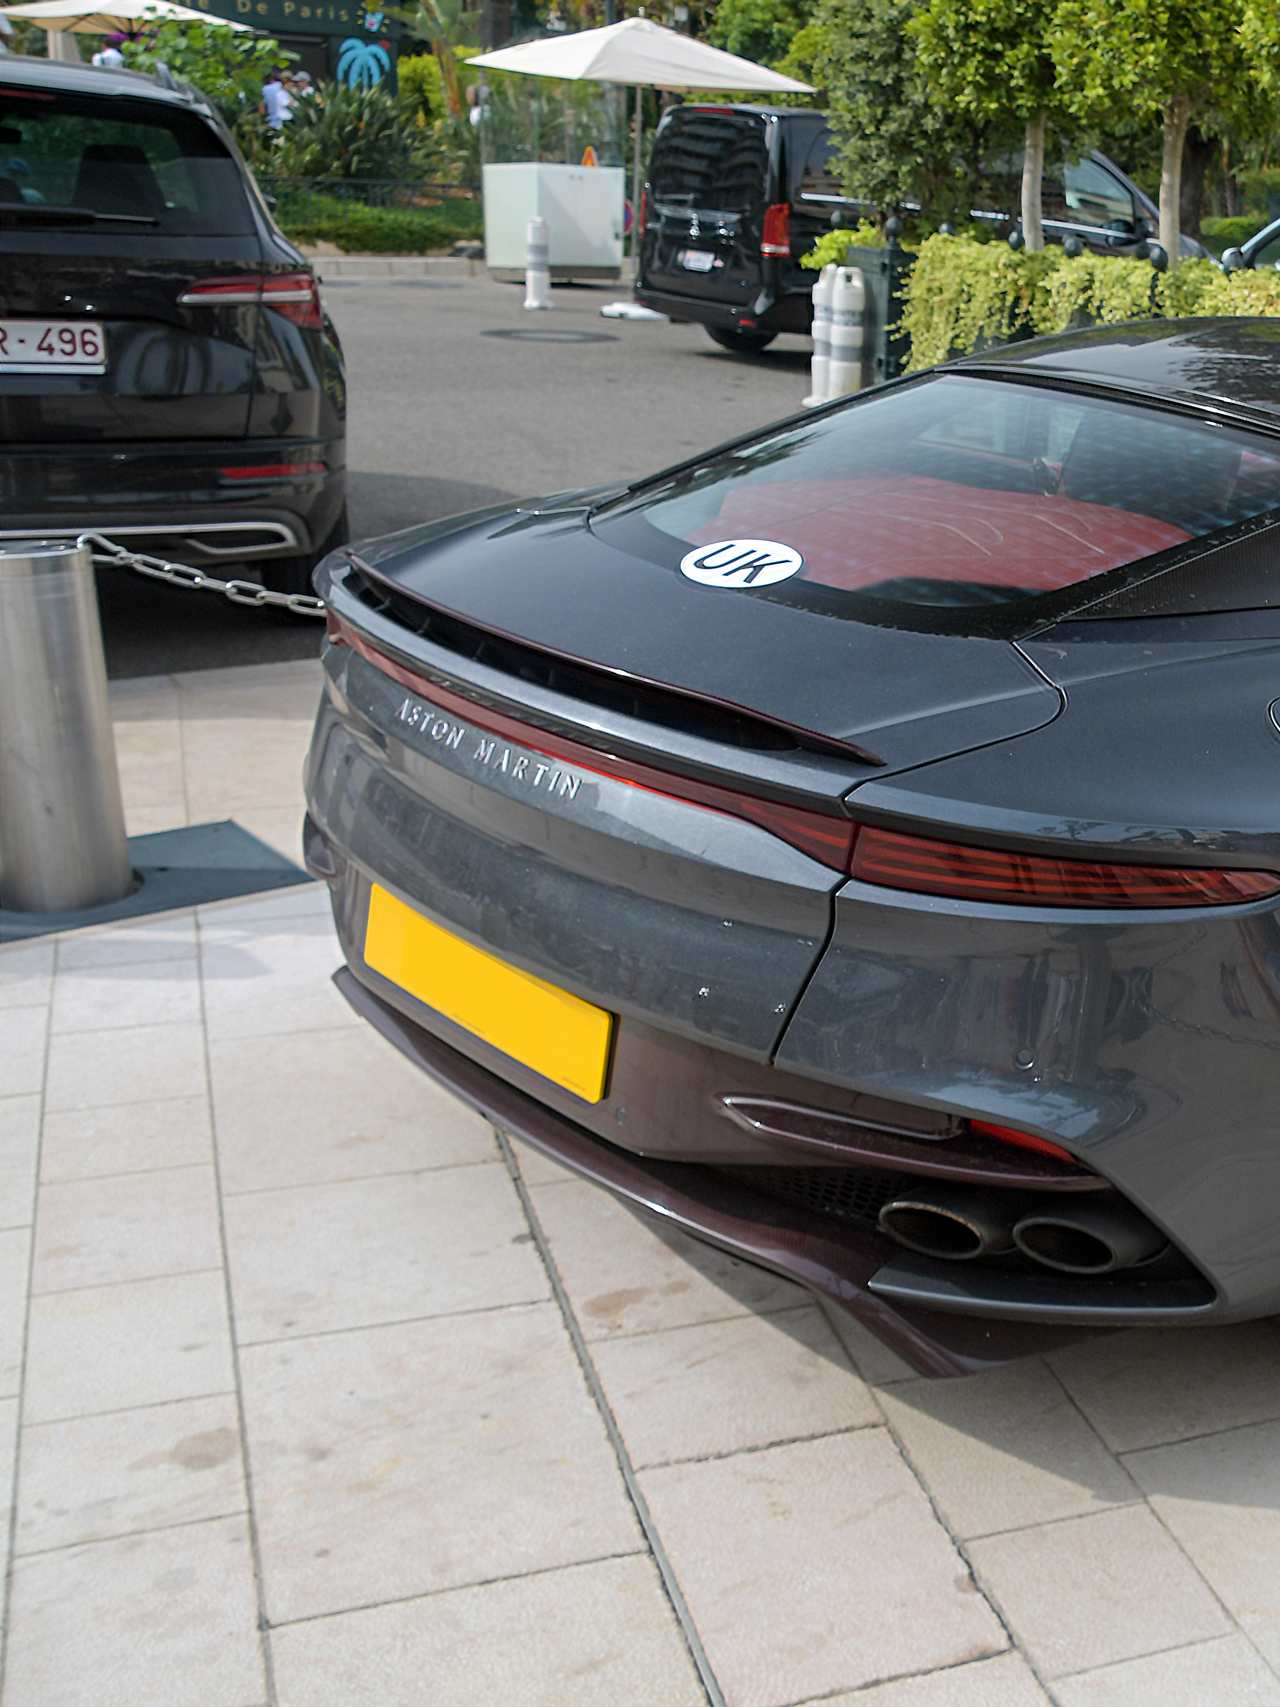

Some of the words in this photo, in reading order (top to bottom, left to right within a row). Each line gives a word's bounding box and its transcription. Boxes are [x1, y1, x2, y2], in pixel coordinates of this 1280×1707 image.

[237, 0, 268, 15] De
[284, 1, 349, 22] Paris
[693, 543, 793, 584] UK
[394, 698, 466, 749] ASTON
[473, 738, 583, 800] MARTIN
